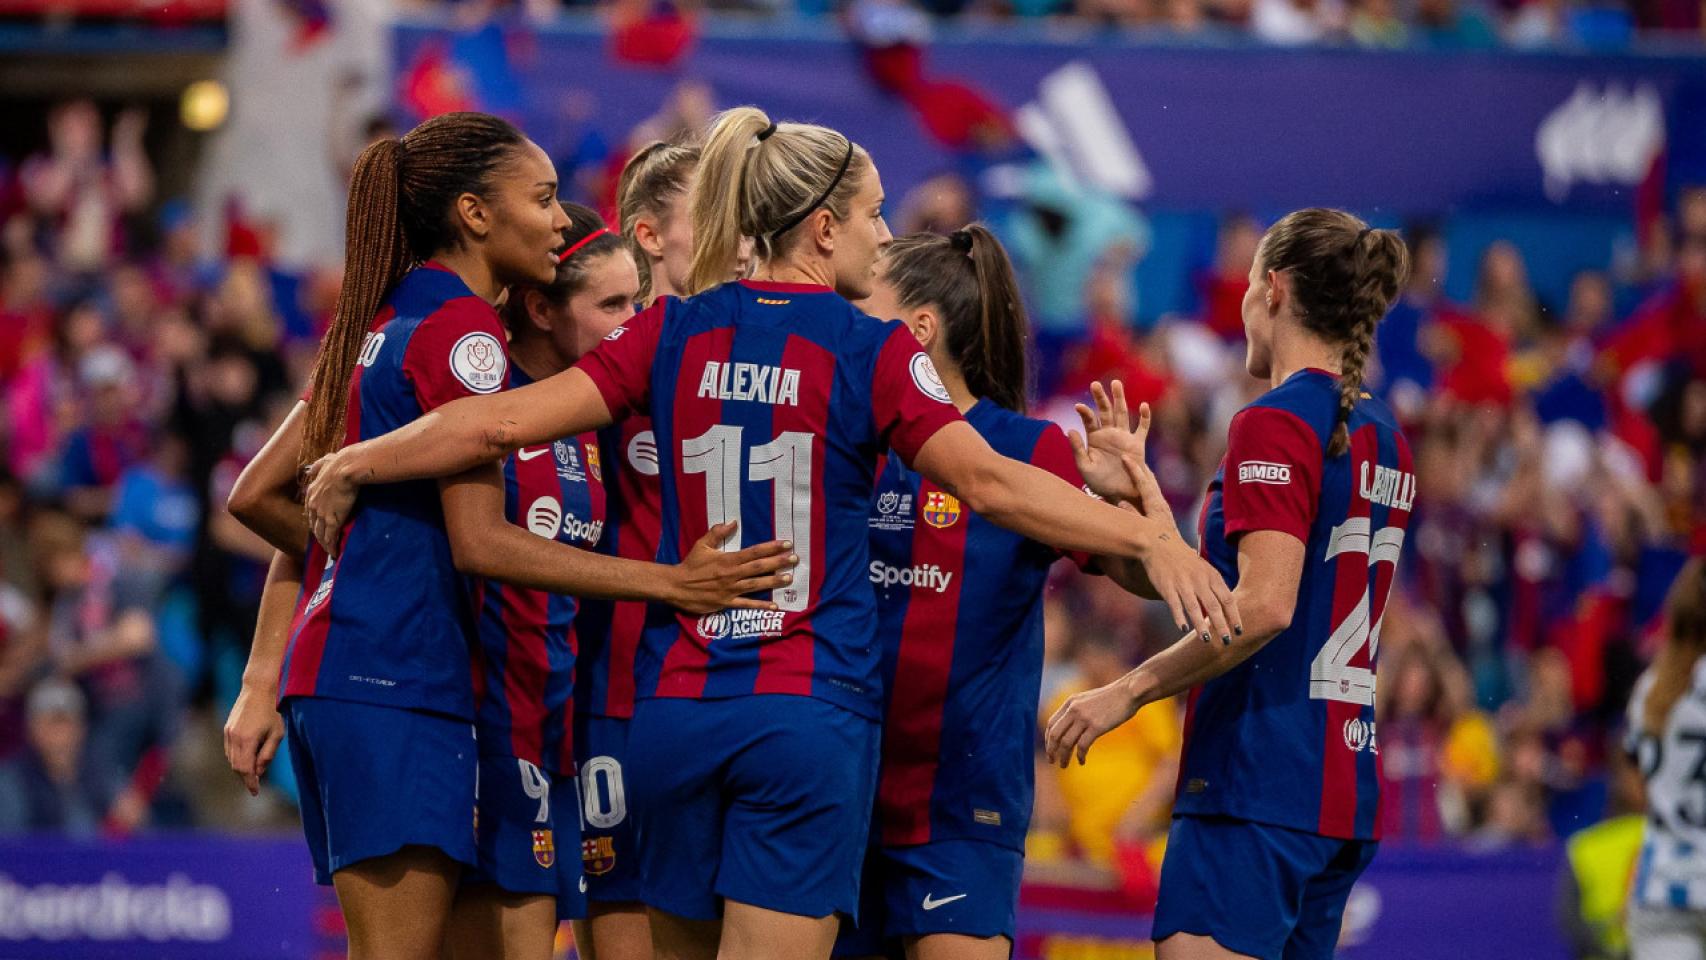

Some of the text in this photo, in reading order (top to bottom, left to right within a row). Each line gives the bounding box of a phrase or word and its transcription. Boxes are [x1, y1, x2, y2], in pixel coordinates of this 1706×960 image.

[697, 361, 801, 406] ALEXIA
[1239, 464, 1291, 481] BIMBO
[681, 425, 814, 611] 11
[869, 560, 953, 593] Spotify
[731, 609, 786, 622] UNHCR
[732, 618, 783, 636] ACNUR
[518, 758, 549, 822] 9
[0, 871, 233, 942] berdrola
